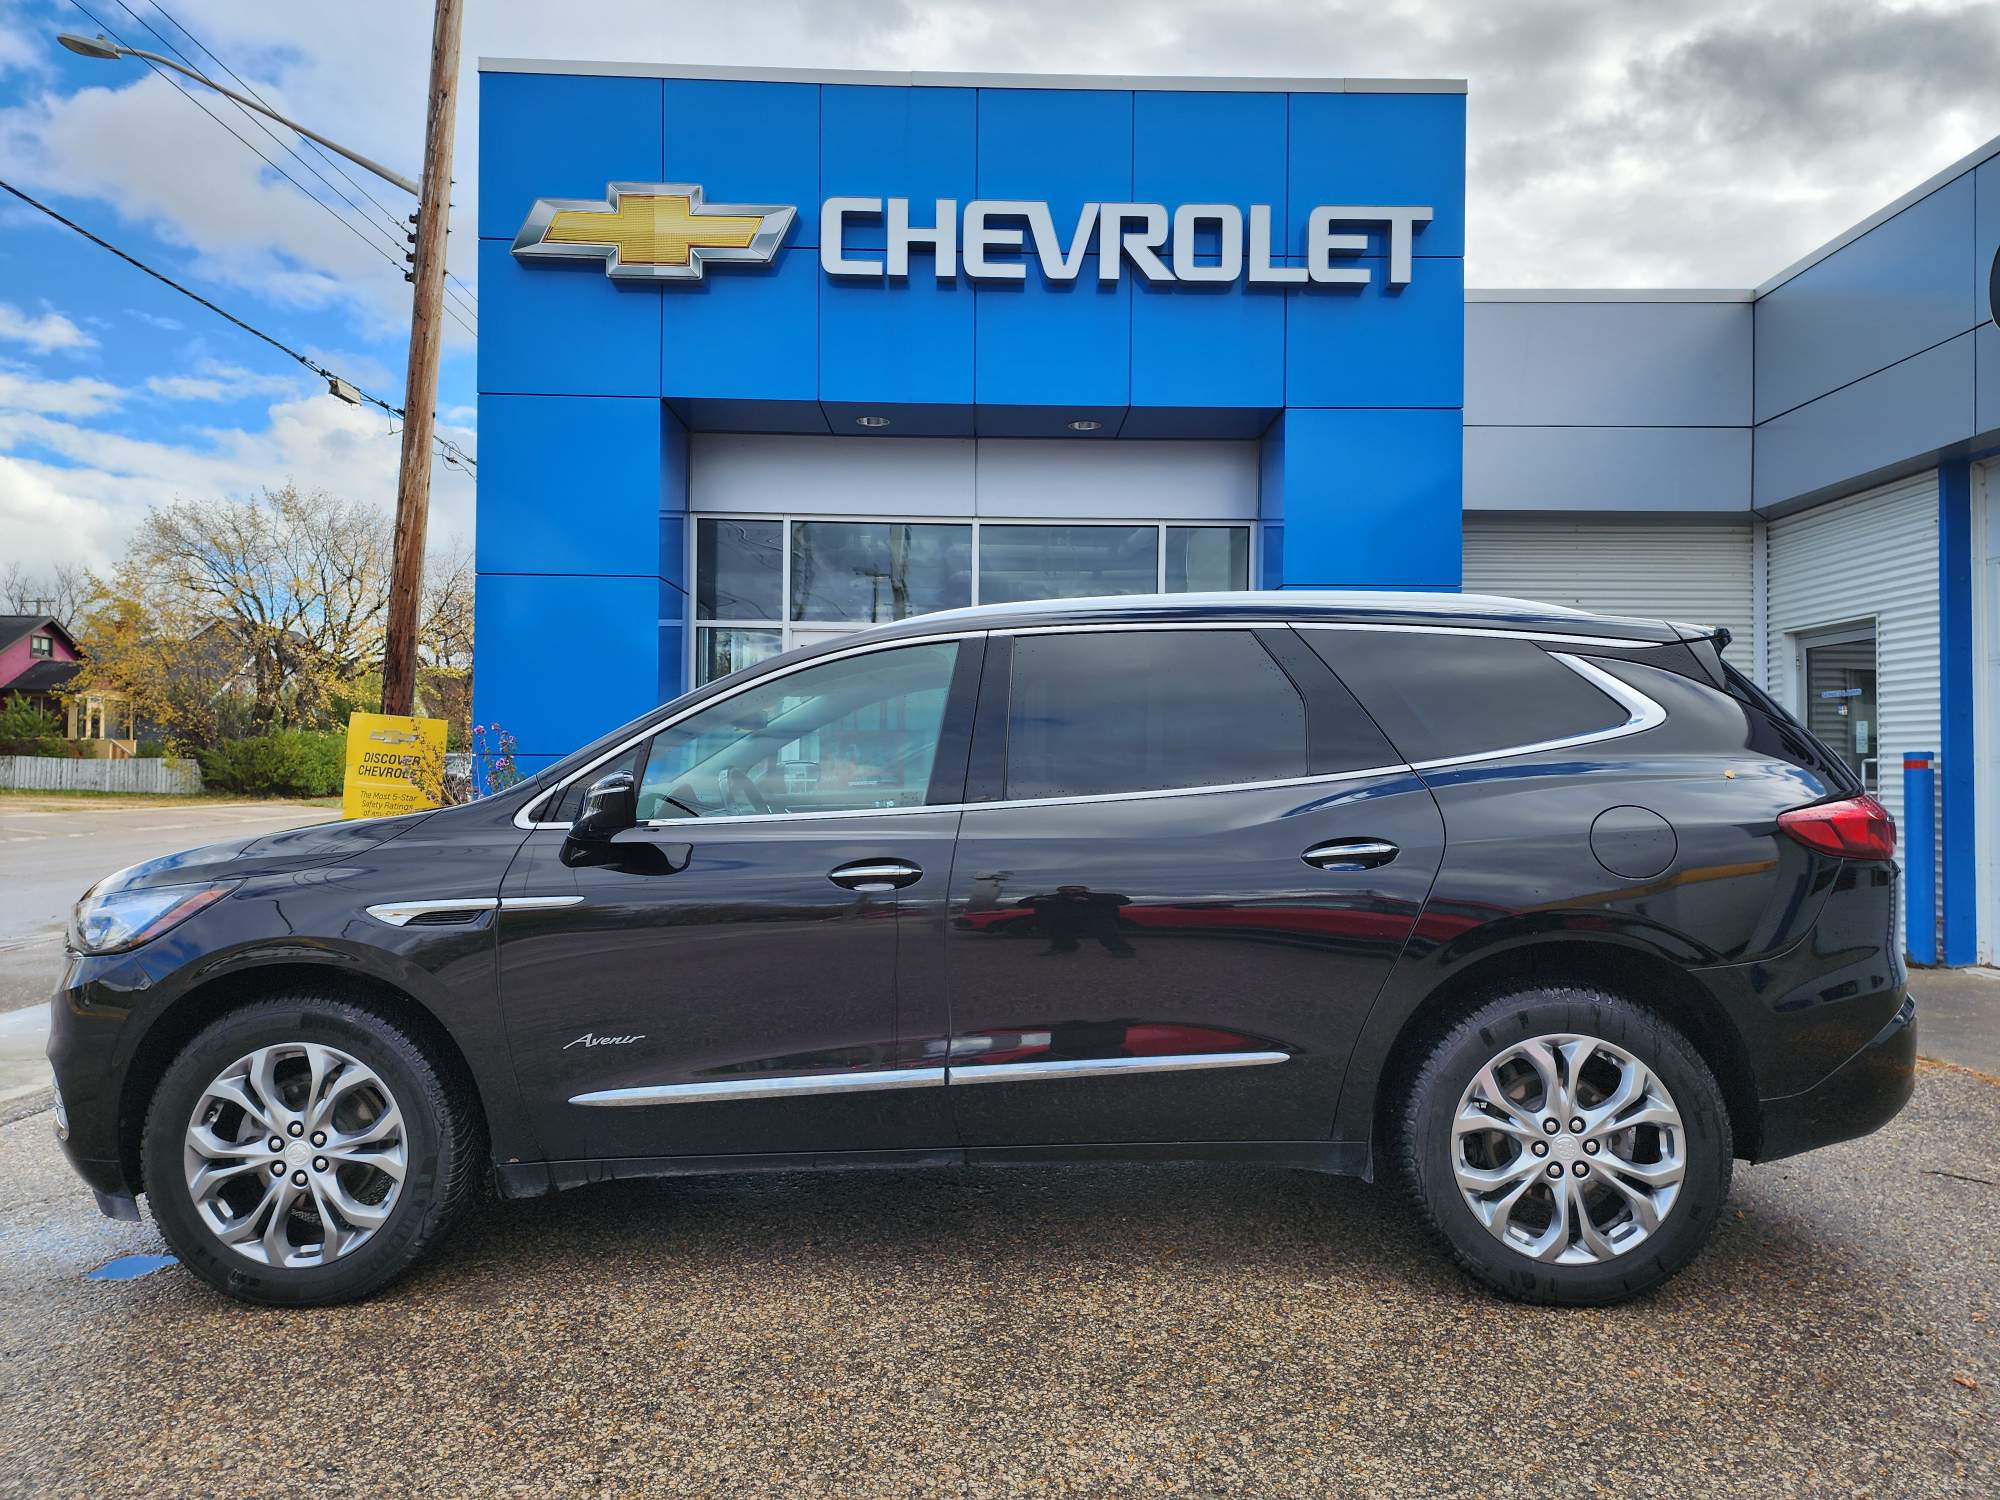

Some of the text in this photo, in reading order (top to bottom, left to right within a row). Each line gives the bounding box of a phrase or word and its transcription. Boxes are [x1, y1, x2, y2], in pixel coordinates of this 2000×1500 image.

[820, 197, 1434, 284] CHEVROLET
[358, 765, 426, 779] CHEVROLT
[361, 790, 417, 802] The Most 5-Star
[362, 800, 382, 810] Safety
[562, 1032, 647, 1050] Avenir
